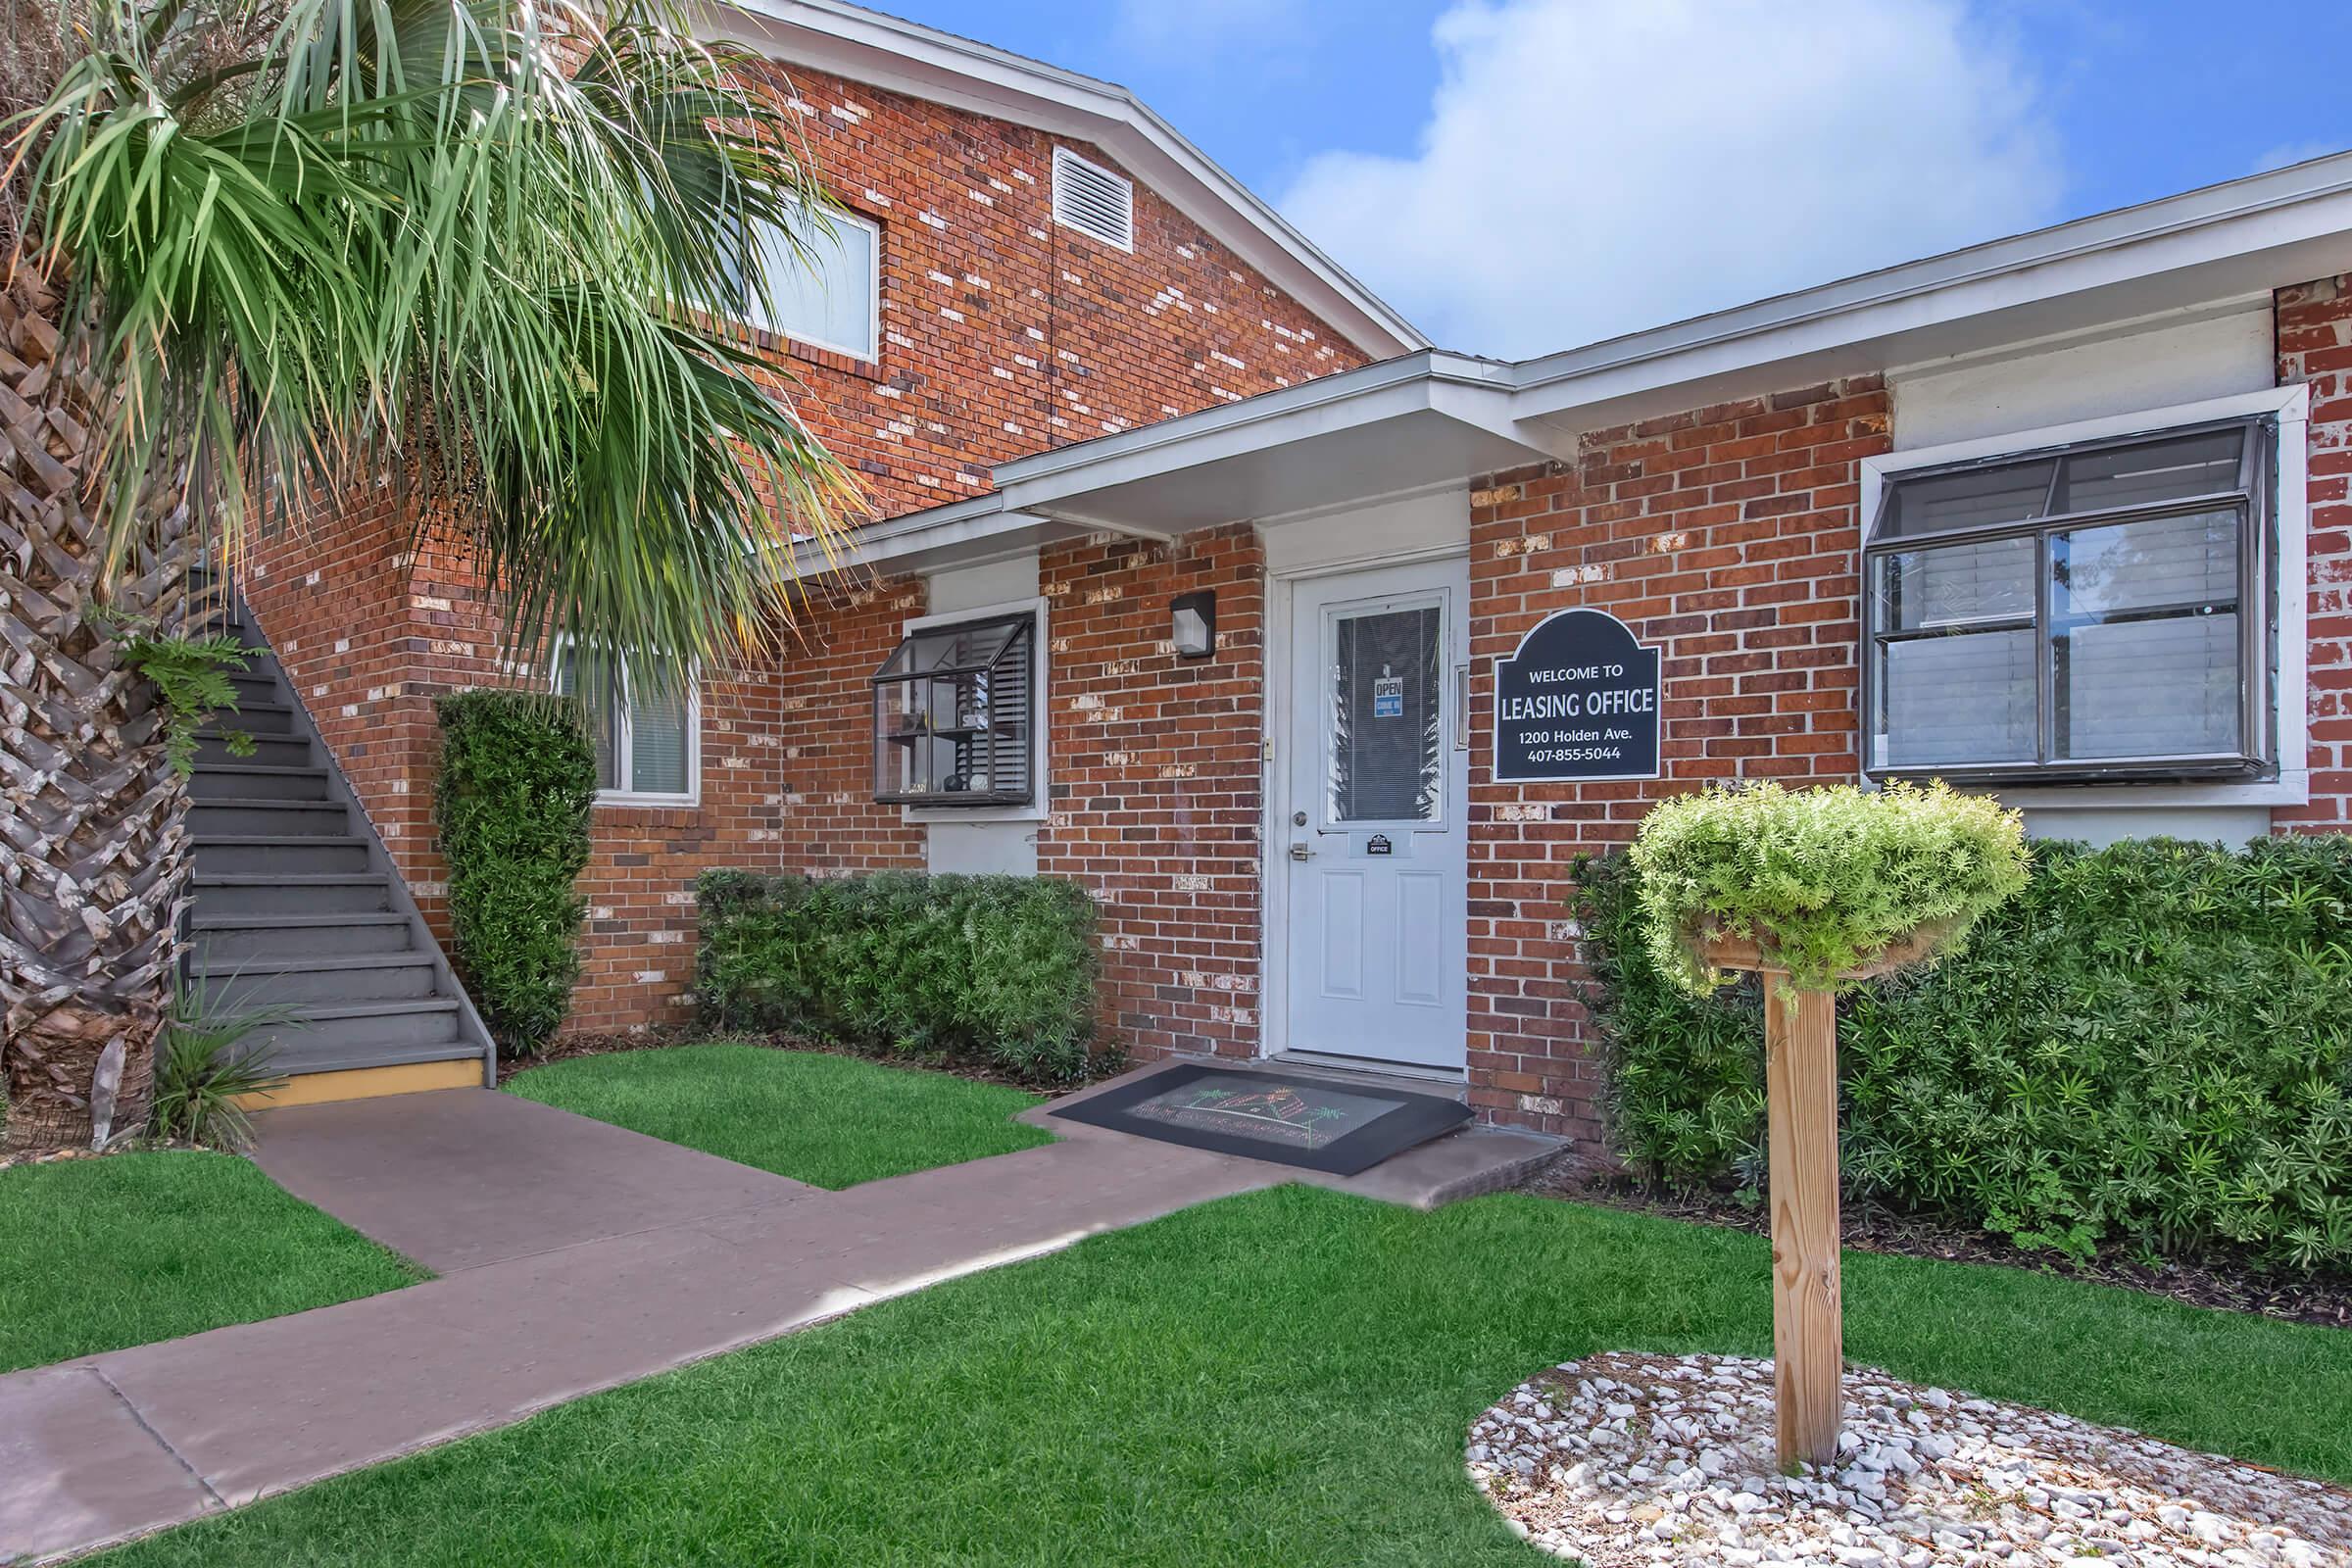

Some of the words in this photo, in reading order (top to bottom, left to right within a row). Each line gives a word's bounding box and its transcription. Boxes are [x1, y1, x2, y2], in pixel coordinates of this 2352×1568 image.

[1529, 666, 1599, 683] WELCOME
[1602, 664, 1623, 677] TO
[1377, 682, 1401, 696] OPEN
[1501, 693, 1580, 720] LEASING
[1586, 688, 1654, 715] OFFICE
[1519, 731, 1549, 745] 1200
[1553, 729, 1599, 743] Holden
[1603, 728, 1633, 740] Ave.
[1527, 747, 1621, 762] 407-855-5044
